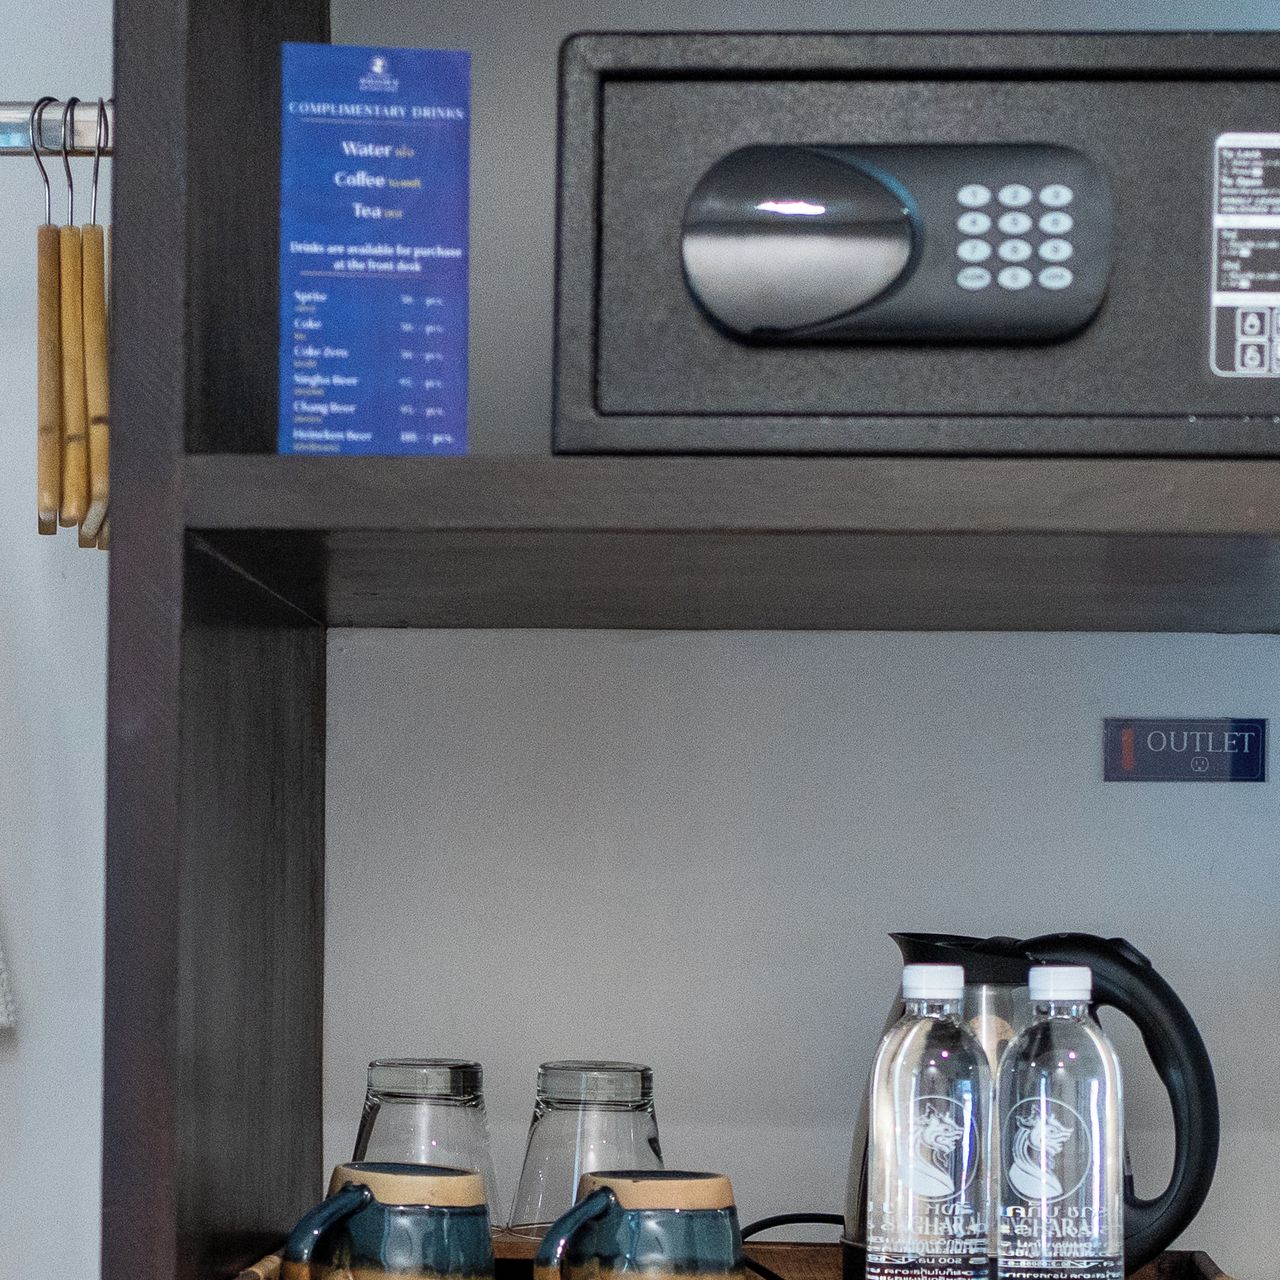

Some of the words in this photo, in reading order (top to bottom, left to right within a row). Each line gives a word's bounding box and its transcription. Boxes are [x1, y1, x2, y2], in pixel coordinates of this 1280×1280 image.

[288, 101, 407, 118] COMPLIMENTARY
[411, 105, 465, 120] DRINKS
[342, 140, 393, 158] Water
[334, 170, 385, 187] Coffee
[352, 202, 382, 219] Tea
[290, 241, 324, 254] Drinks
[413, 245, 462, 259] purchase
[347, 259, 366, 271] the
[396, 260, 422, 272] desk
[1147, 730, 1256, 753] OUTLET
